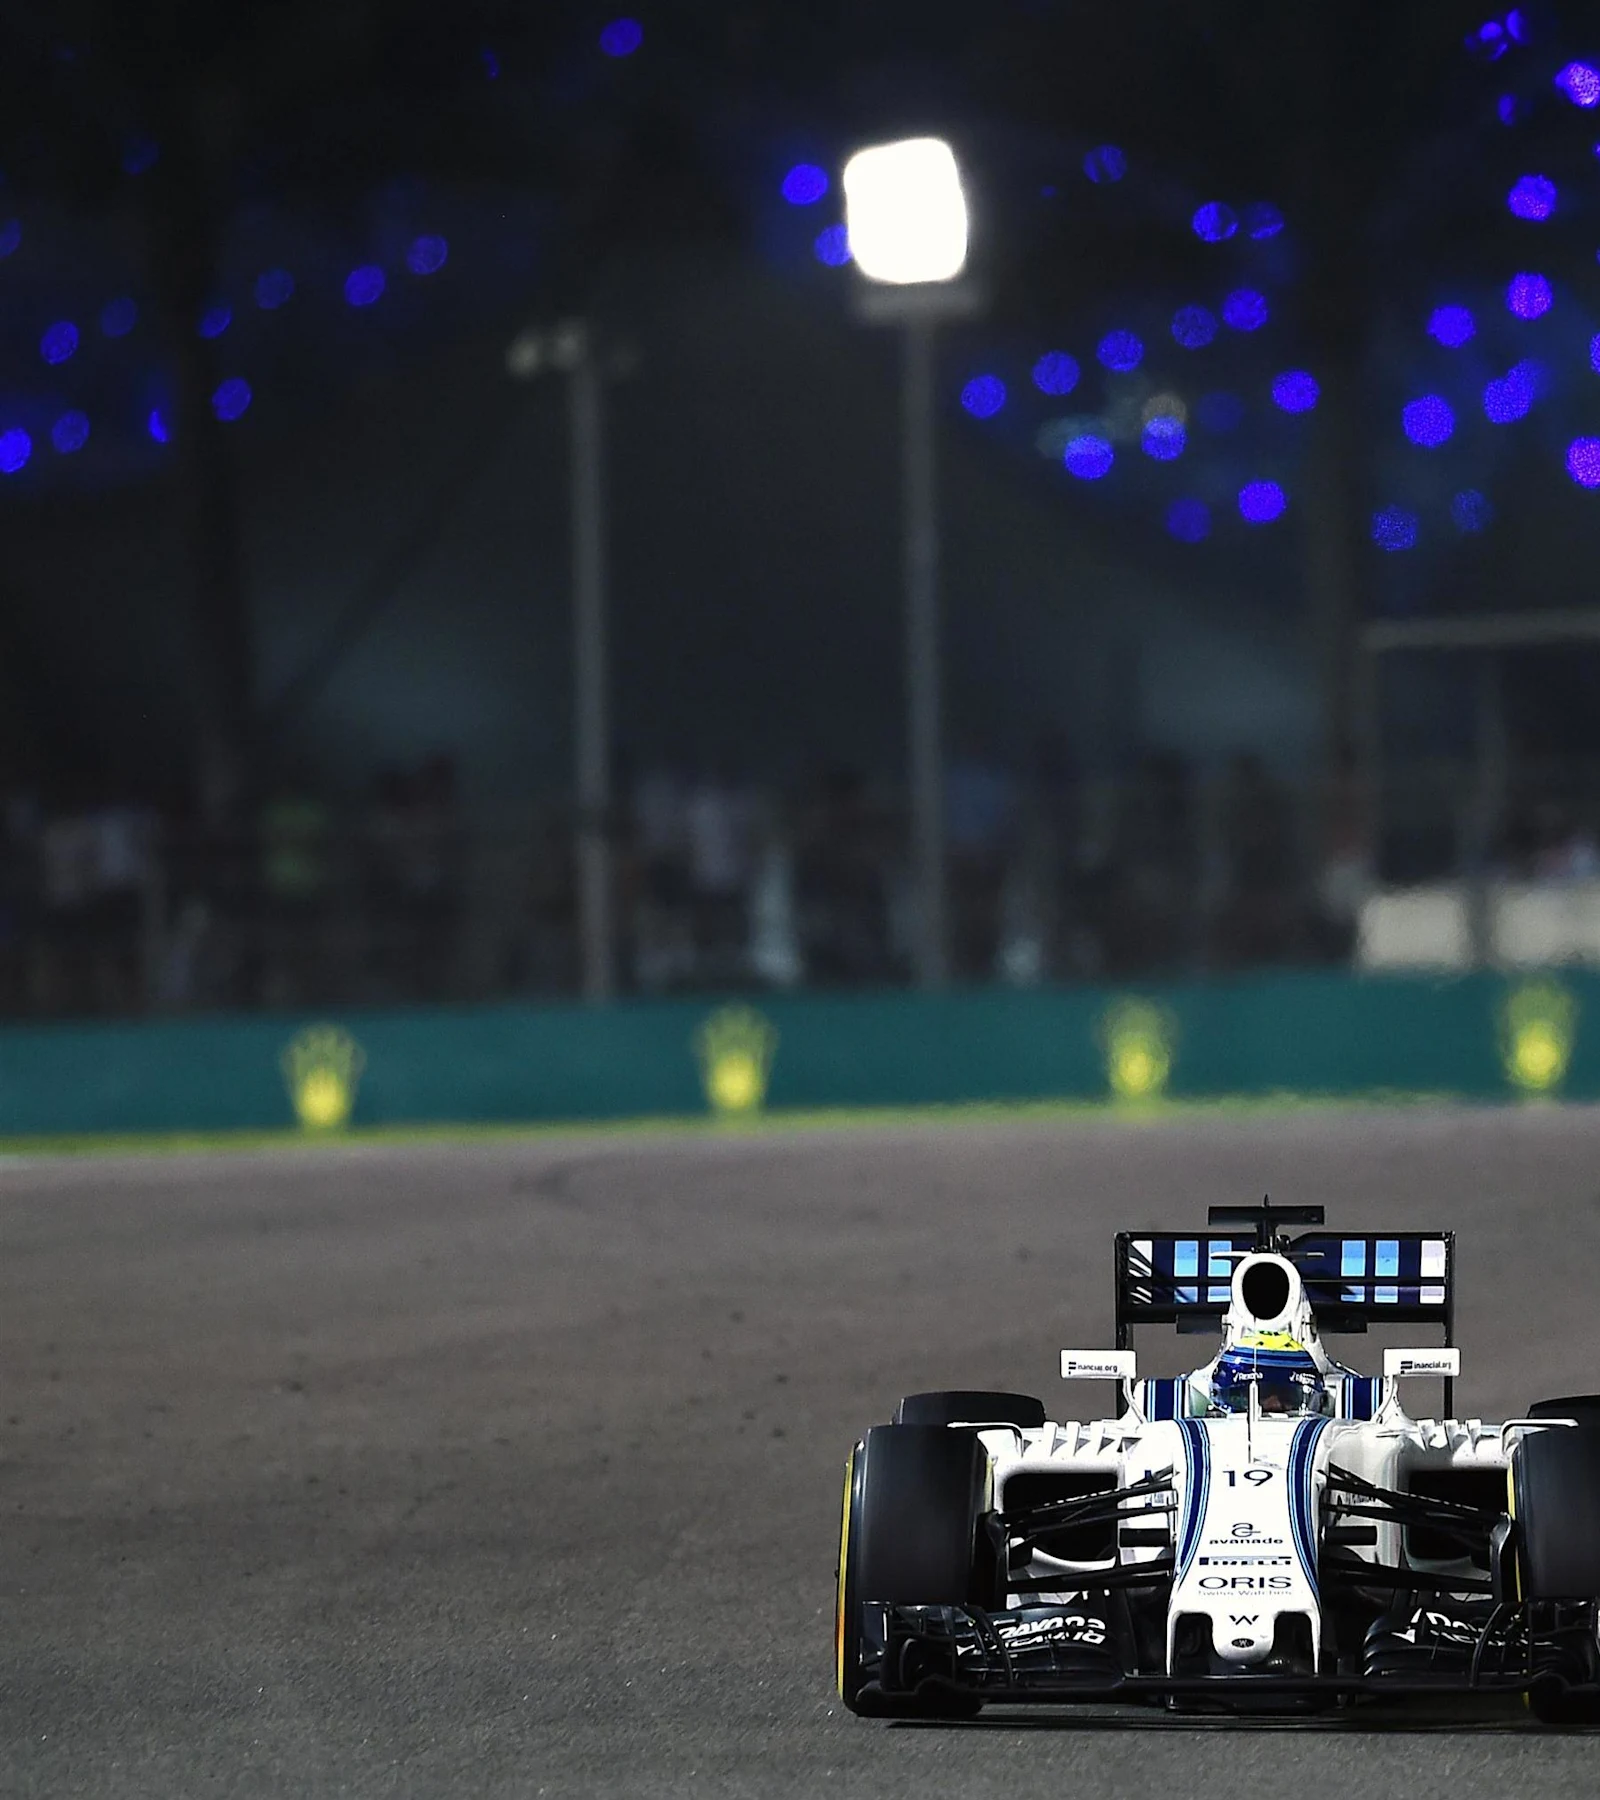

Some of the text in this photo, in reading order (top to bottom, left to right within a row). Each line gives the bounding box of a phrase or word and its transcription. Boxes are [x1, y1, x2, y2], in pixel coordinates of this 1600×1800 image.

[1222, 1469, 1274, 1487] 19
[1209, 1537, 1284, 1545] avanade
[1198, 1576, 1292, 1589] ORIS
